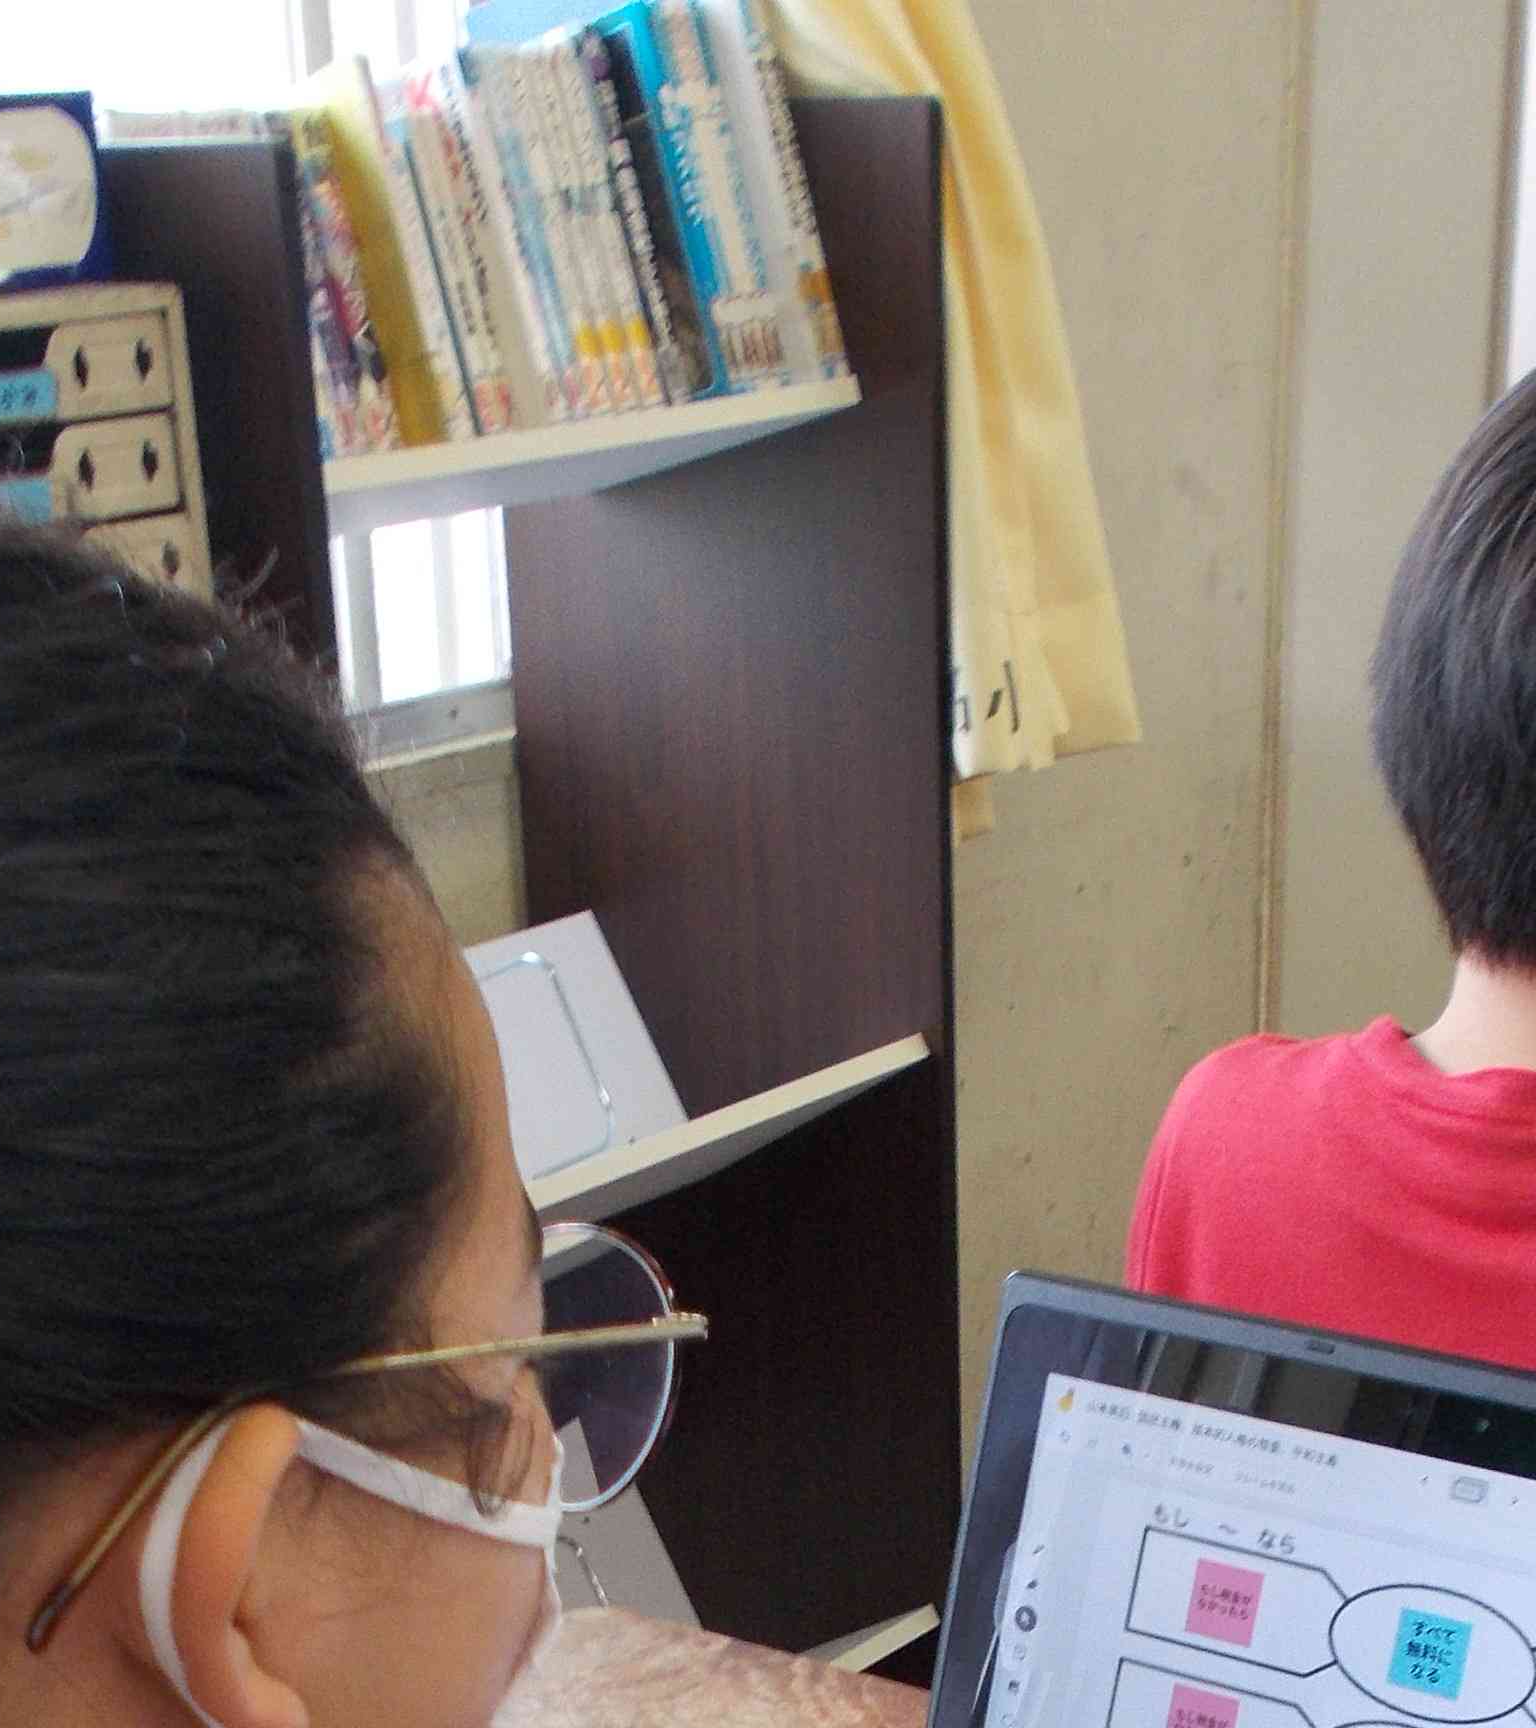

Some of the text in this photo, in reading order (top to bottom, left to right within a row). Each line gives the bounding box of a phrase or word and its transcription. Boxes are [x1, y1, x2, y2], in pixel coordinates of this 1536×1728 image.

[1154, 1503, 1190, 1528] もし
[1257, 1527, 1296, 1555] なら
[1412, 1620, 1457, 1644] すべて
[1408, 1662, 1441, 1685] なる
